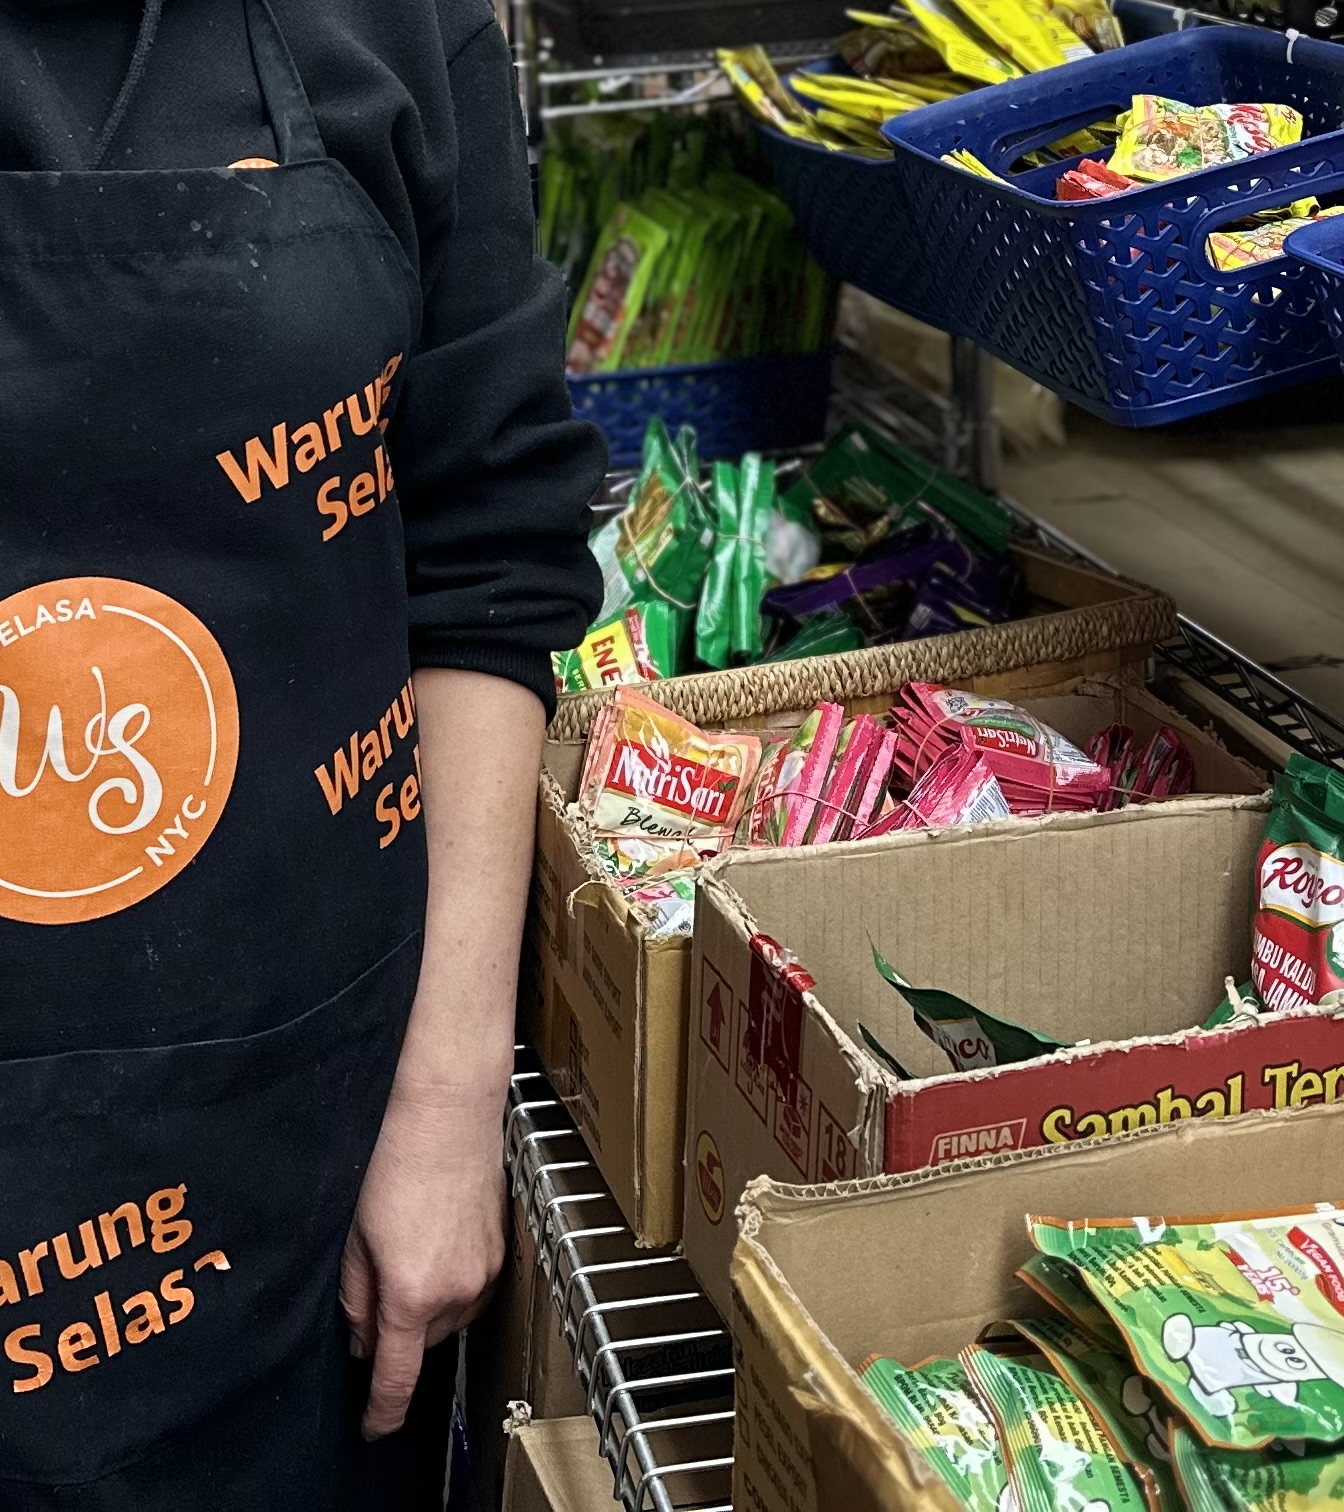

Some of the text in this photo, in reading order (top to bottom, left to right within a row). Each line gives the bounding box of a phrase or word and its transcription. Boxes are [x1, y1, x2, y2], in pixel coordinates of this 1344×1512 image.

[612, 744, 726, 818] NutriSari
[144, 794, 207, 868] NYC
[1280, 951, 1318, 996] KALDU
[1041, 1068, 1242, 1148] Sambal
[823, 1122, 847, 1174] 18
[937, 1126, 1014, 1160] FINNA
[1299, 1237, 1333, 1275] VEGAN
[3, 1249, 231, 1393] Selas
